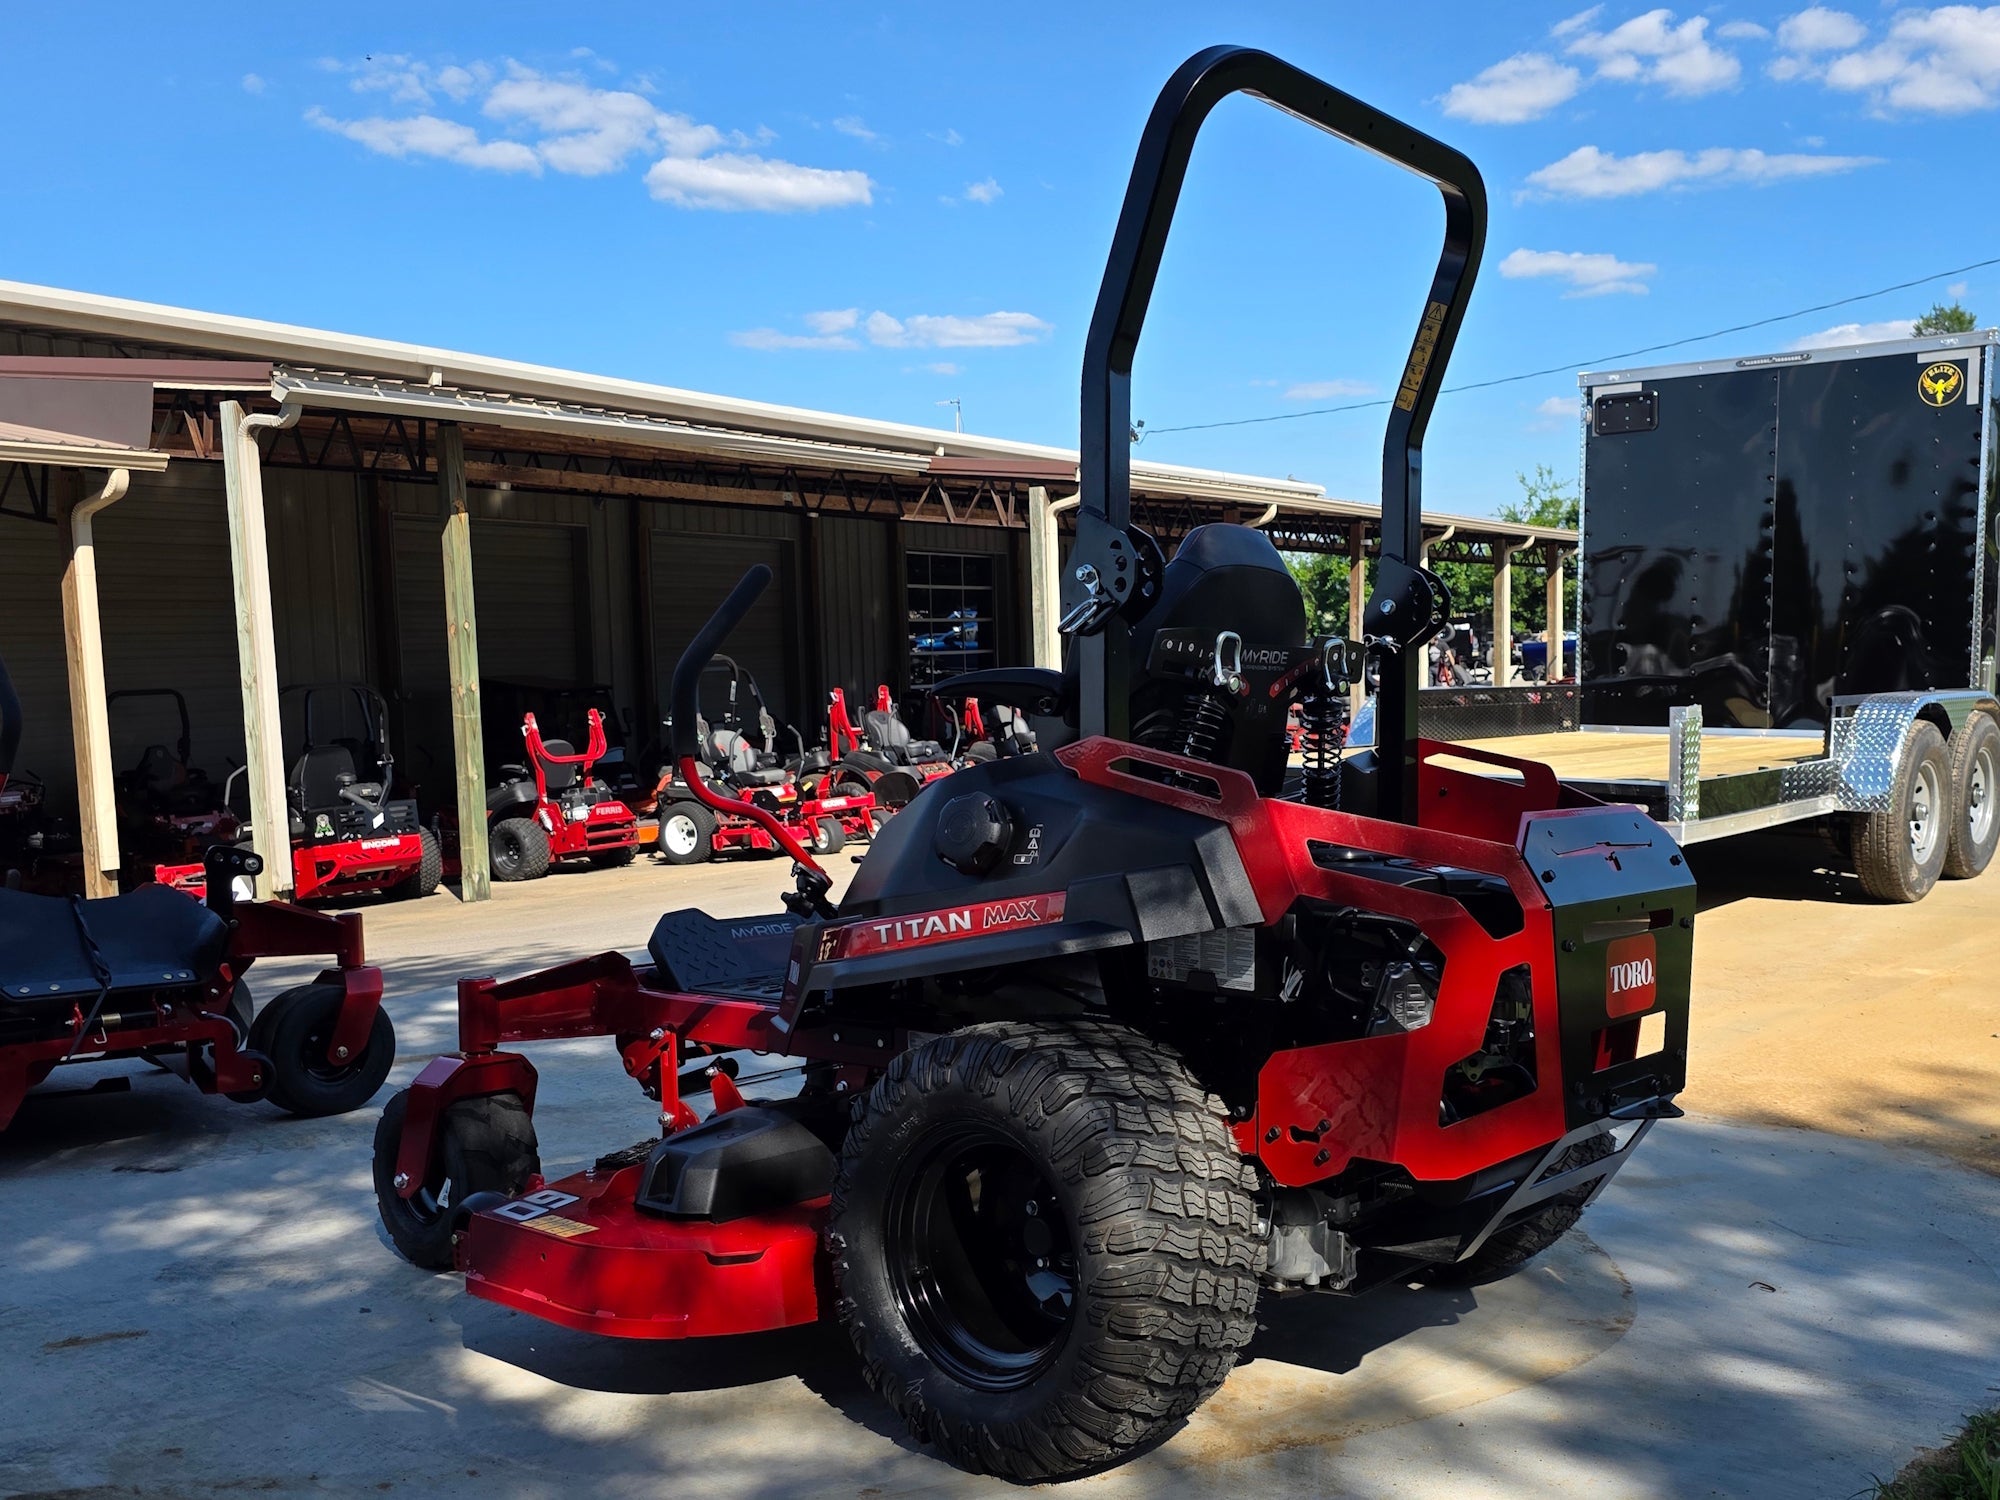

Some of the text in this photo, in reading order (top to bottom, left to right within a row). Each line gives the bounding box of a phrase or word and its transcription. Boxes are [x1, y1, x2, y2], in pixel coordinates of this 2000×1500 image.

[1927, 365, 1955, 377] ELITE
[595, 805, 623, 816] FERRIS
[873, 899, 1041, 944] TITAN MAX
[1610, 957, 1654, 993] TORO
